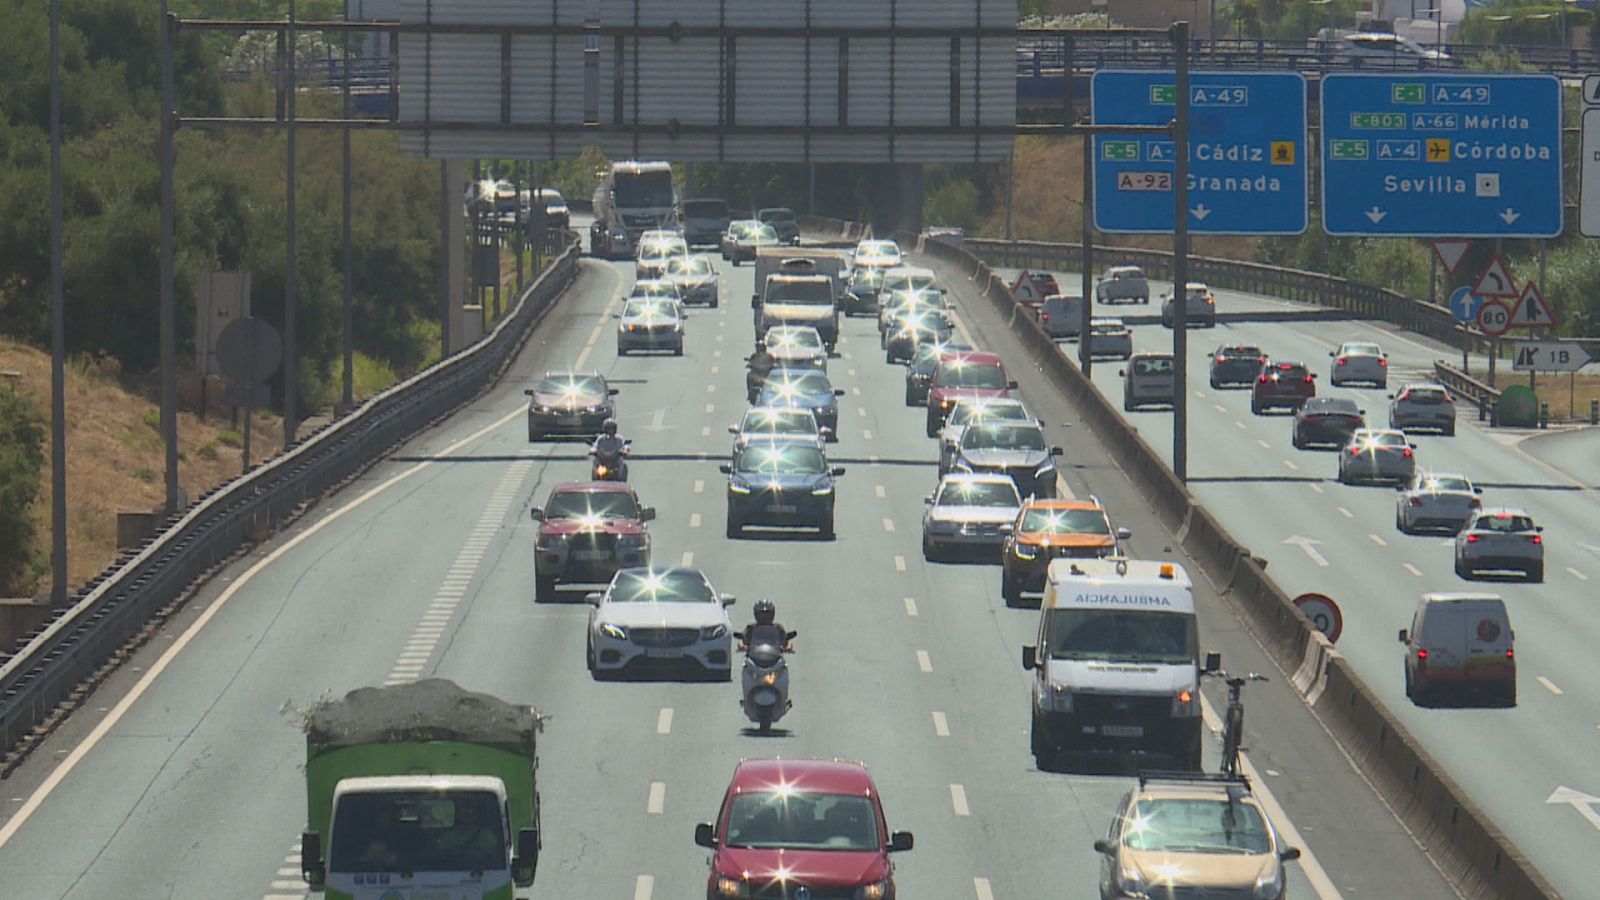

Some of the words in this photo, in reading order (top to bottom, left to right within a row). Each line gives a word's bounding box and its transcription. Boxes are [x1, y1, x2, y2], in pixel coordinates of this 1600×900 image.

[1152, 88, 1176, 102] E-
[1194, 88, 1244, 102] A-49
[1394, 87, 1423, 101] E-1
[1436, 87, 1488, 101] A-49
[1352, 115, 1404, 127] E-803
[1415, 115, 1455, 127] A-66
[1464, 114, 1529, 129] Mérida
[1104, 144, 1137, 158] E-5
[1196, 143, 1263, 161] Cádiz
[1333, 143, 1366, 156] E-5
[1379, 143, 1416, 157] A-4
[1454, 142, 1550, 160] Córdoba
[1121, 175, 1170, 189] A-92
[1186, 174, 1281, 192] Granada
[1384, 175, 1466, 193] Sevilla
[1483, 312, 1506, 324] 80
